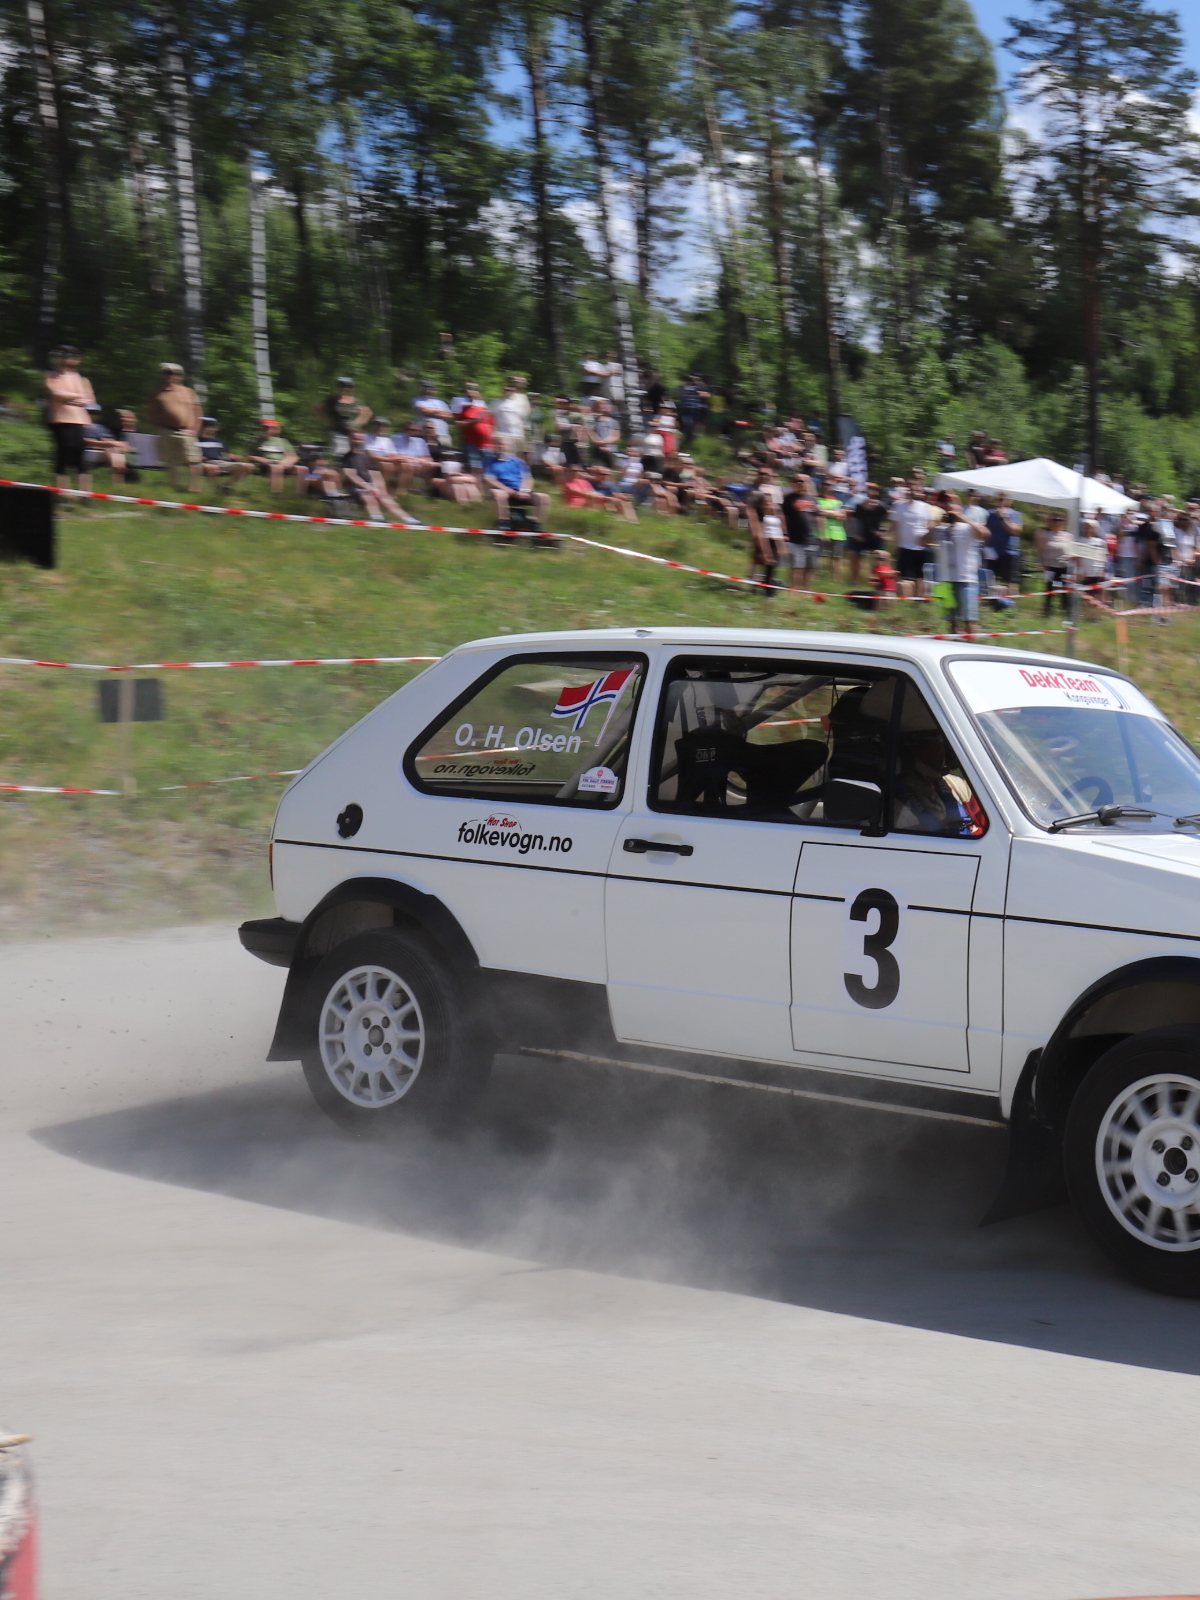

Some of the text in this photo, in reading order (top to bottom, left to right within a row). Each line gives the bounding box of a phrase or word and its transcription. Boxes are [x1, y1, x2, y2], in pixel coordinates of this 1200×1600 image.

[1018, 669, 1101, 693] DekkTeam
[454, 723, 582, 753] O. H. Olsen
[457, 821, 573, 855] folkevogn.no
[844, 887, 901, 1010] 3
